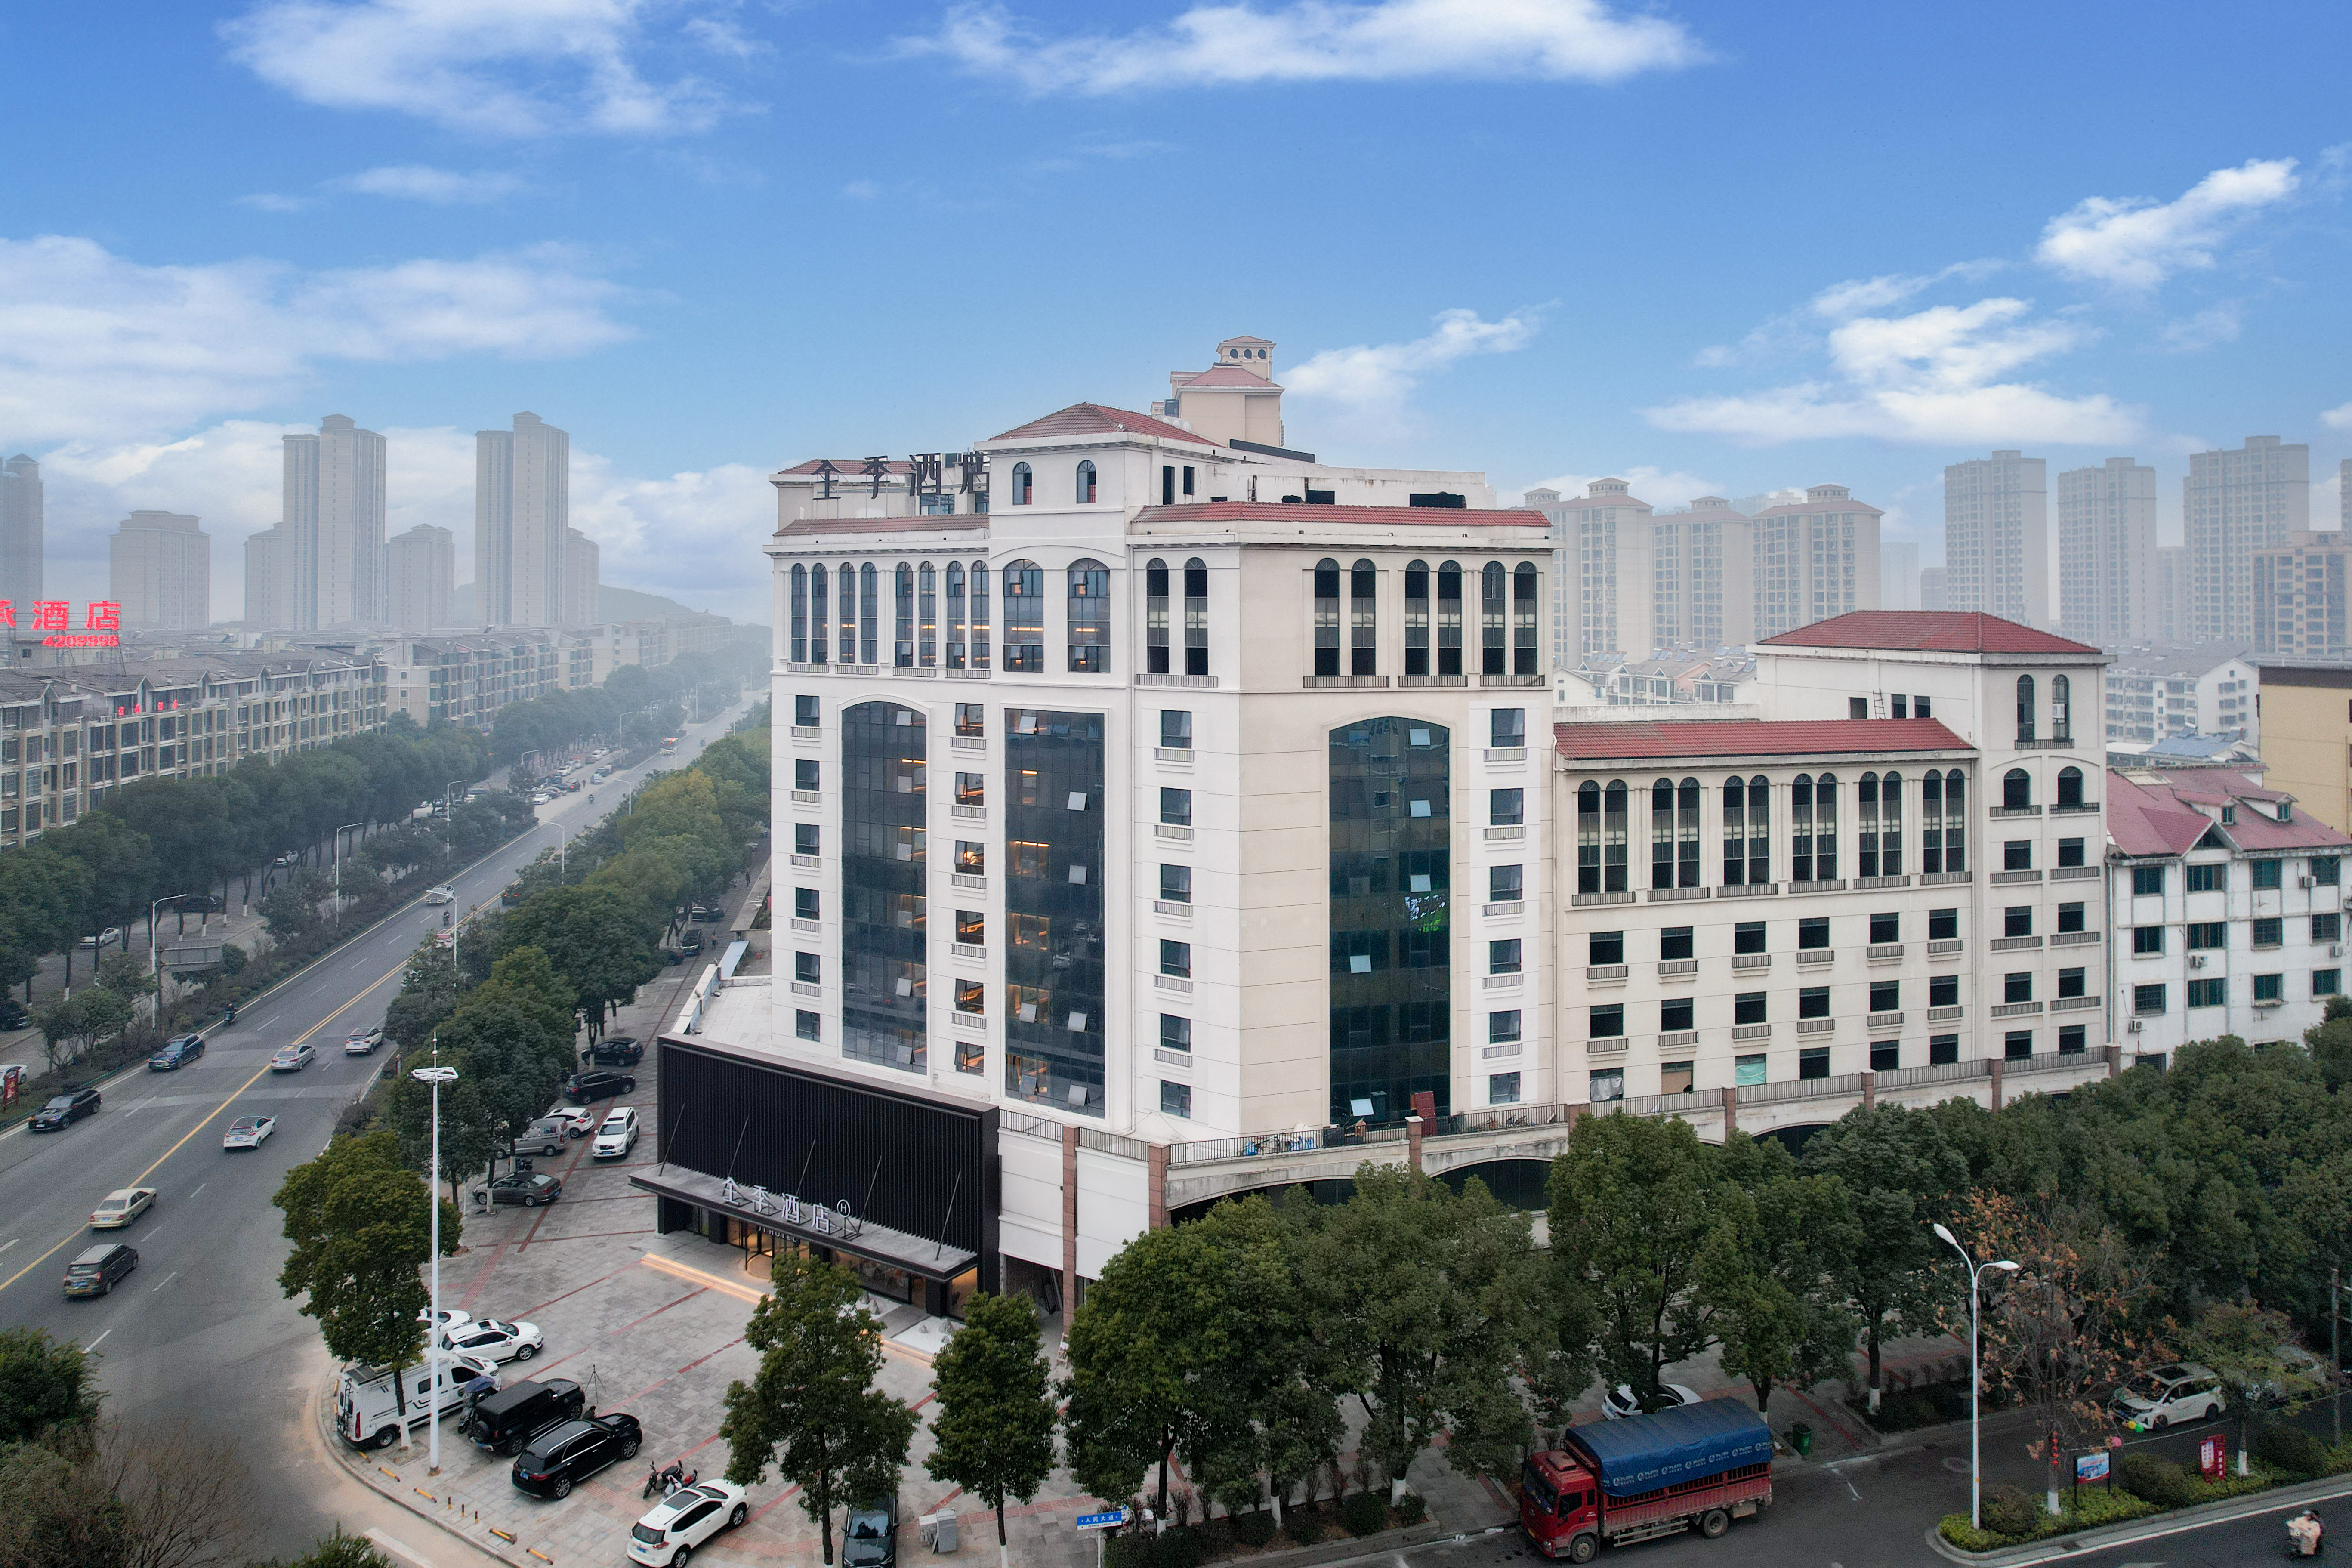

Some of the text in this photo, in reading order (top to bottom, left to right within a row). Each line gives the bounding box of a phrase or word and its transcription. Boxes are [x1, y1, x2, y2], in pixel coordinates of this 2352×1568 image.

[811, 451, 990, 500] 全季酒店
[42, 635, 119, 648] 4209998
[722, 1176, 830, 1234] 全季酒店
[1086, 1515, 1114, 1523] 人民大道
